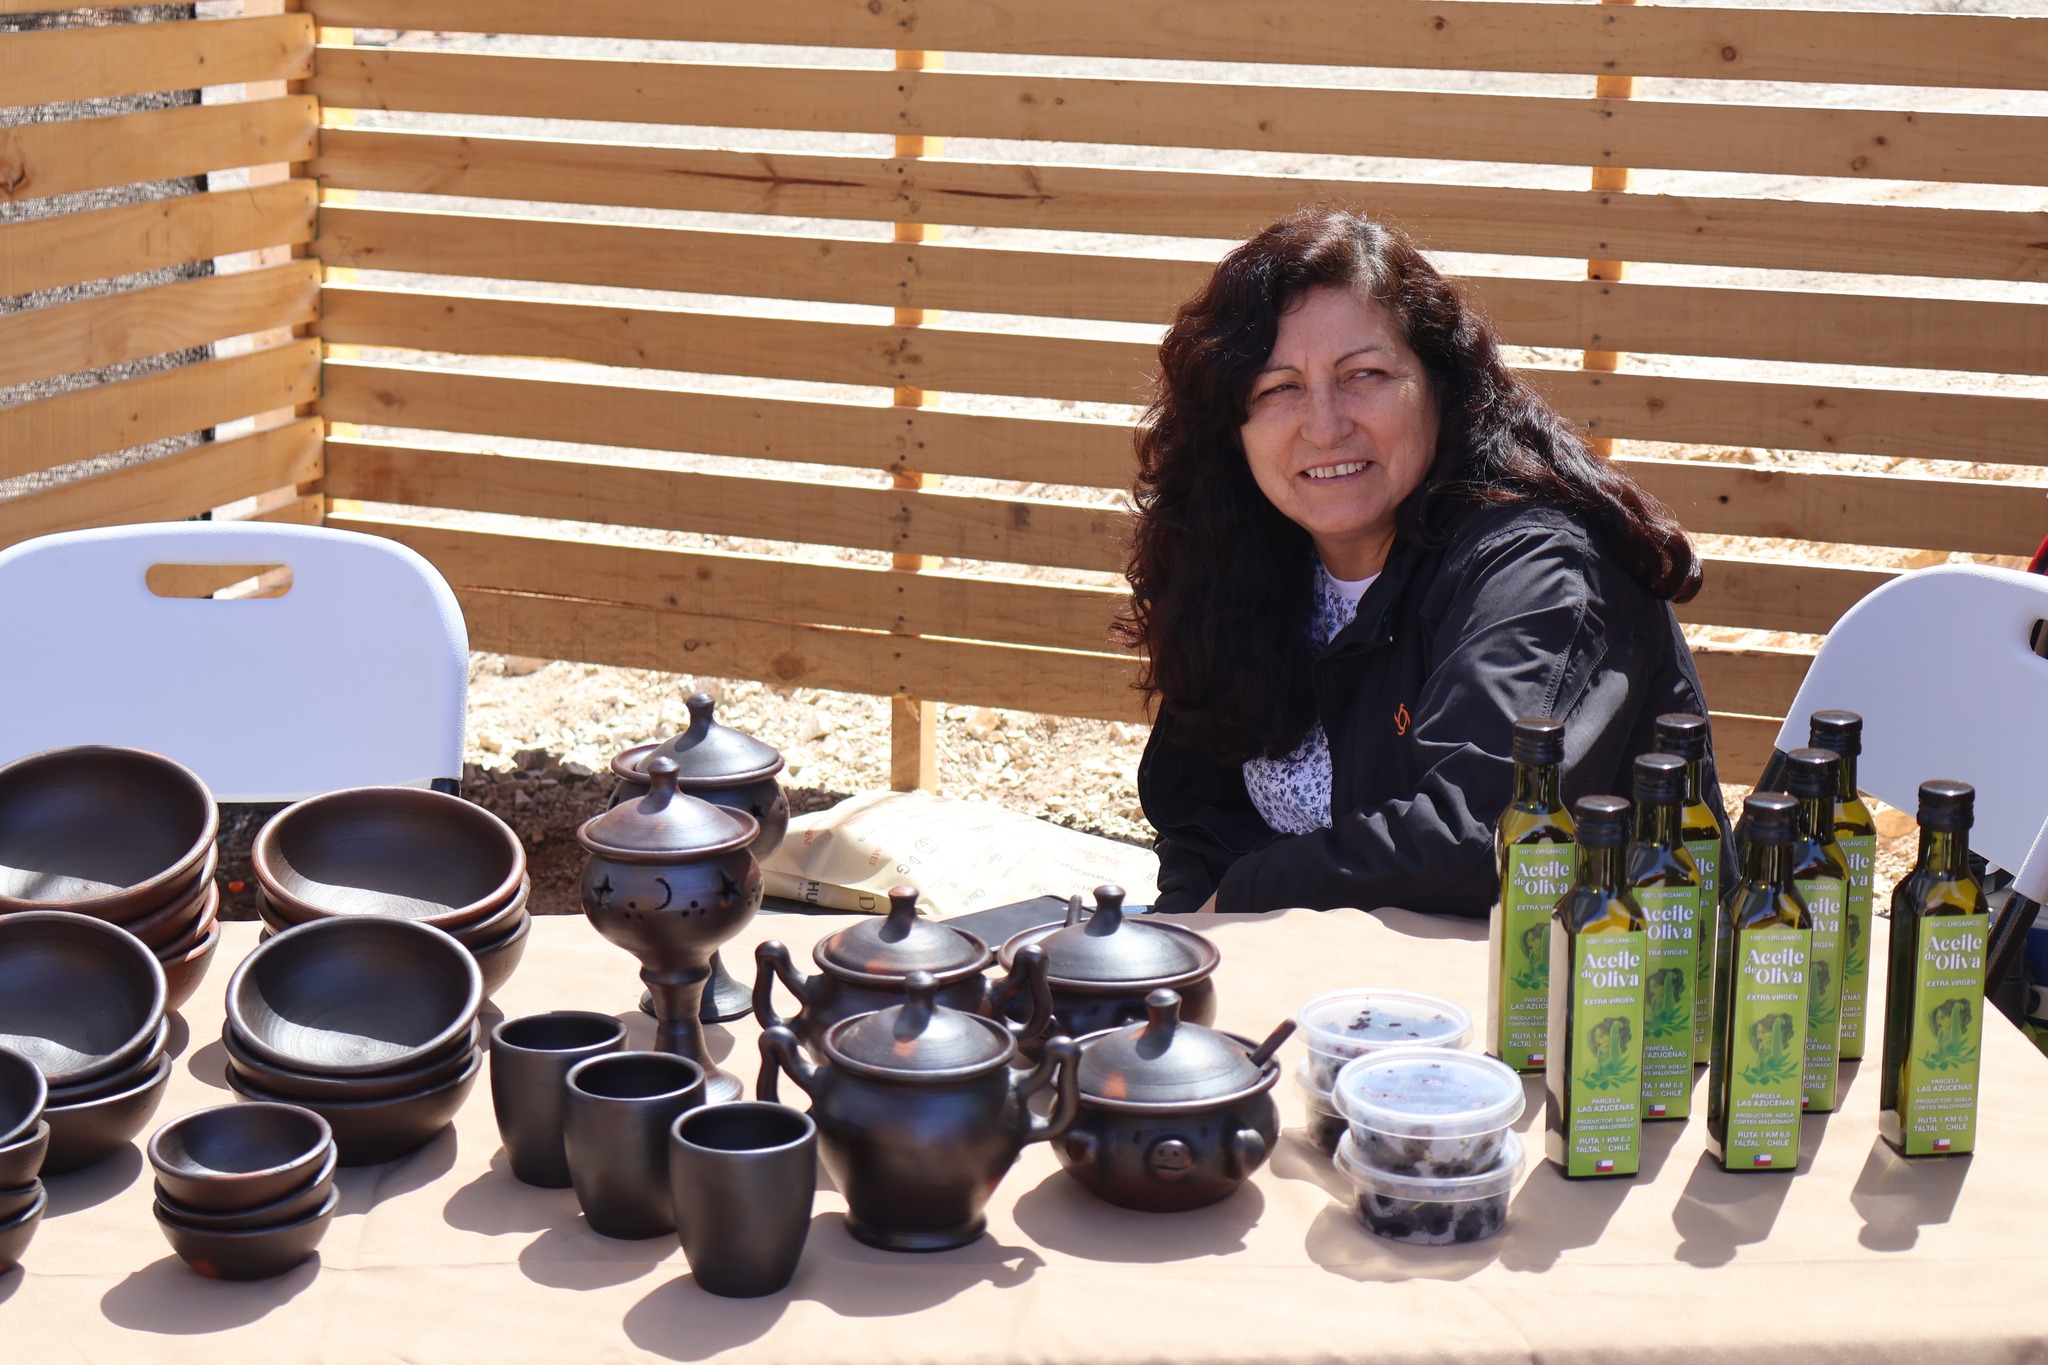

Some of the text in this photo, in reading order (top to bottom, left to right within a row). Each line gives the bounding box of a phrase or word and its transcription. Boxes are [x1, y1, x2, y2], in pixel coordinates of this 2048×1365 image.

[1516, 861, 1570, 879] Aceite
[1696, 857, 1715, 875] ite
[1850, 853, 1870, 871] ite
[1514, 877, 1569, 895] de Oliva
[1808, 898, 1840, 916] eite
[1648, 924, 1693, 940] Oliva
[1813, 916, 1839, 932] iva
[1926, 933, 1983, 953] Aceite
[1583, 950, 1640, 970] Aceite
[1745, 947, 1805, 968] Aceite
[1925, 952, 1981, 971] de Oliva
[1581, 969, 1639, 988] de Oliva
[1744, 964, 1803, 985] de Oliva
[1951, 979, 1977, 987] VIRGEN
[1584, 998, 1608, 1006] EXTRA
[1933, 1083, 1973, 1092] AZUCENAS
[1594, 1103, 1635, 1112] AZUCENAS
[1754, 1099, 1795, 1107] AZUCENAS
[1579, 1137, 1600, 1145] RUTA
[1608, 1144, 1631, 1152] CHILE
